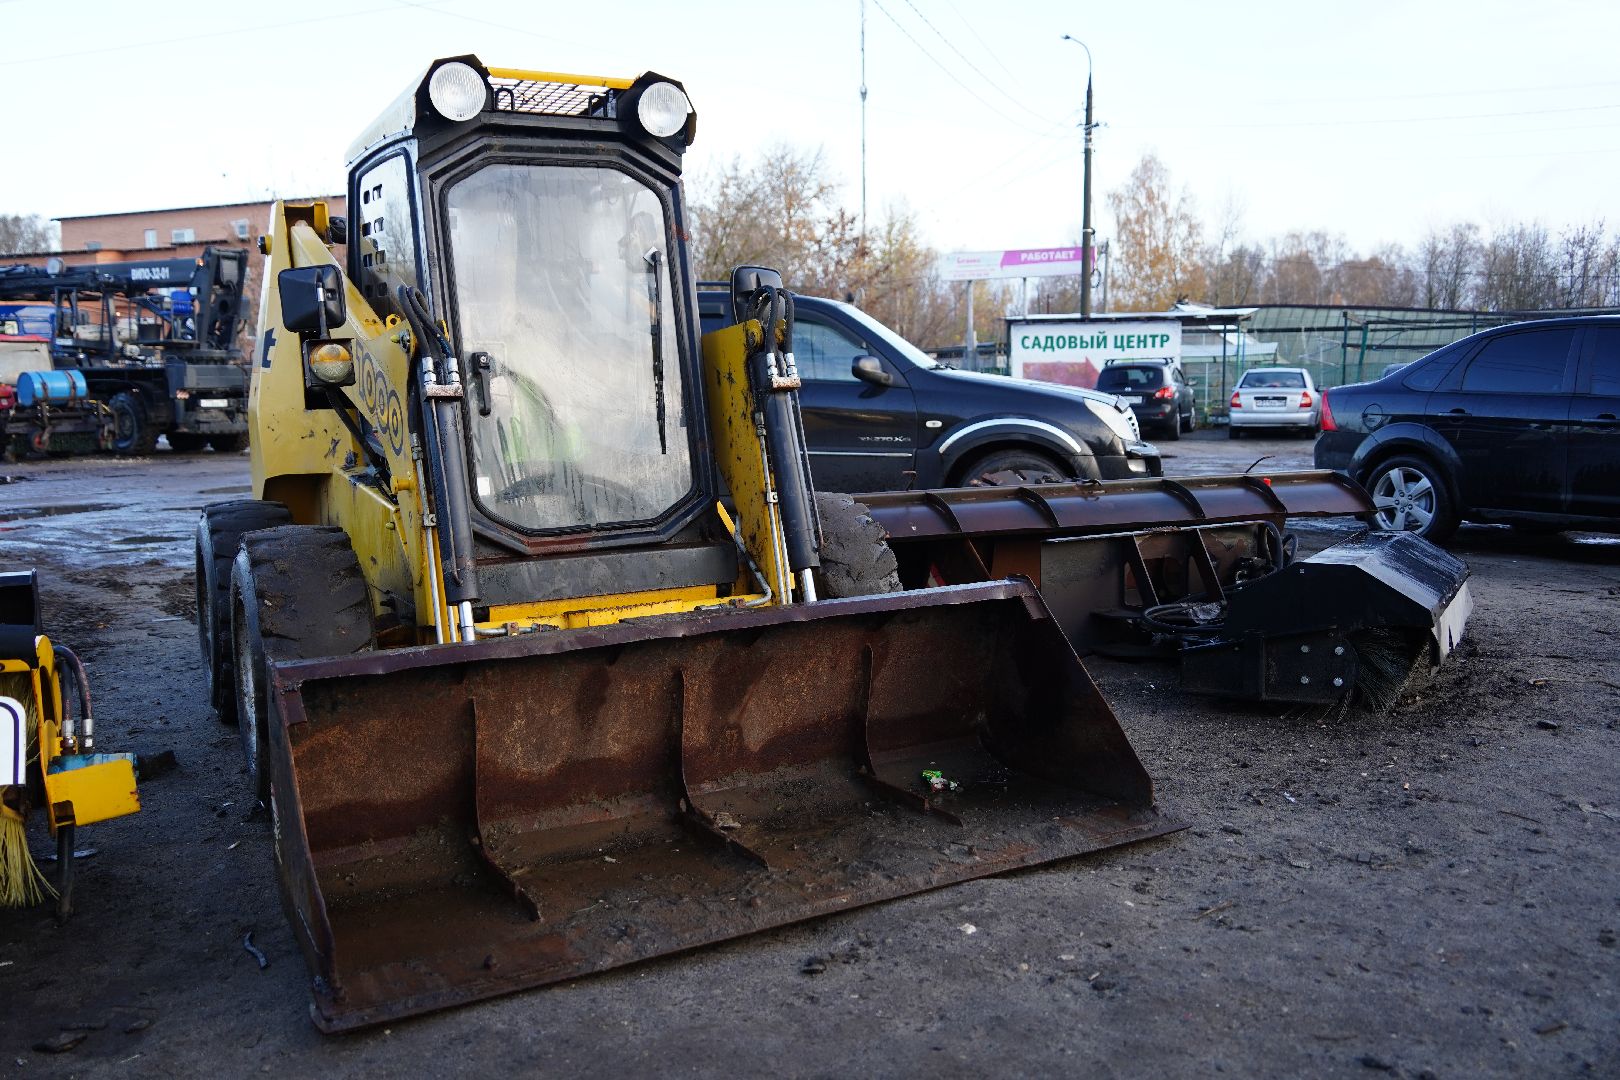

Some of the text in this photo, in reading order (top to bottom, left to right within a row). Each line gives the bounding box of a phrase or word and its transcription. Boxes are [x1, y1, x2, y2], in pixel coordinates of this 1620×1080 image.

[1020, 250, 1076, 262] РАБОТАЕТ
[1021, 331, 1171, 352] САДОВЫЙ ЦЕНТР
